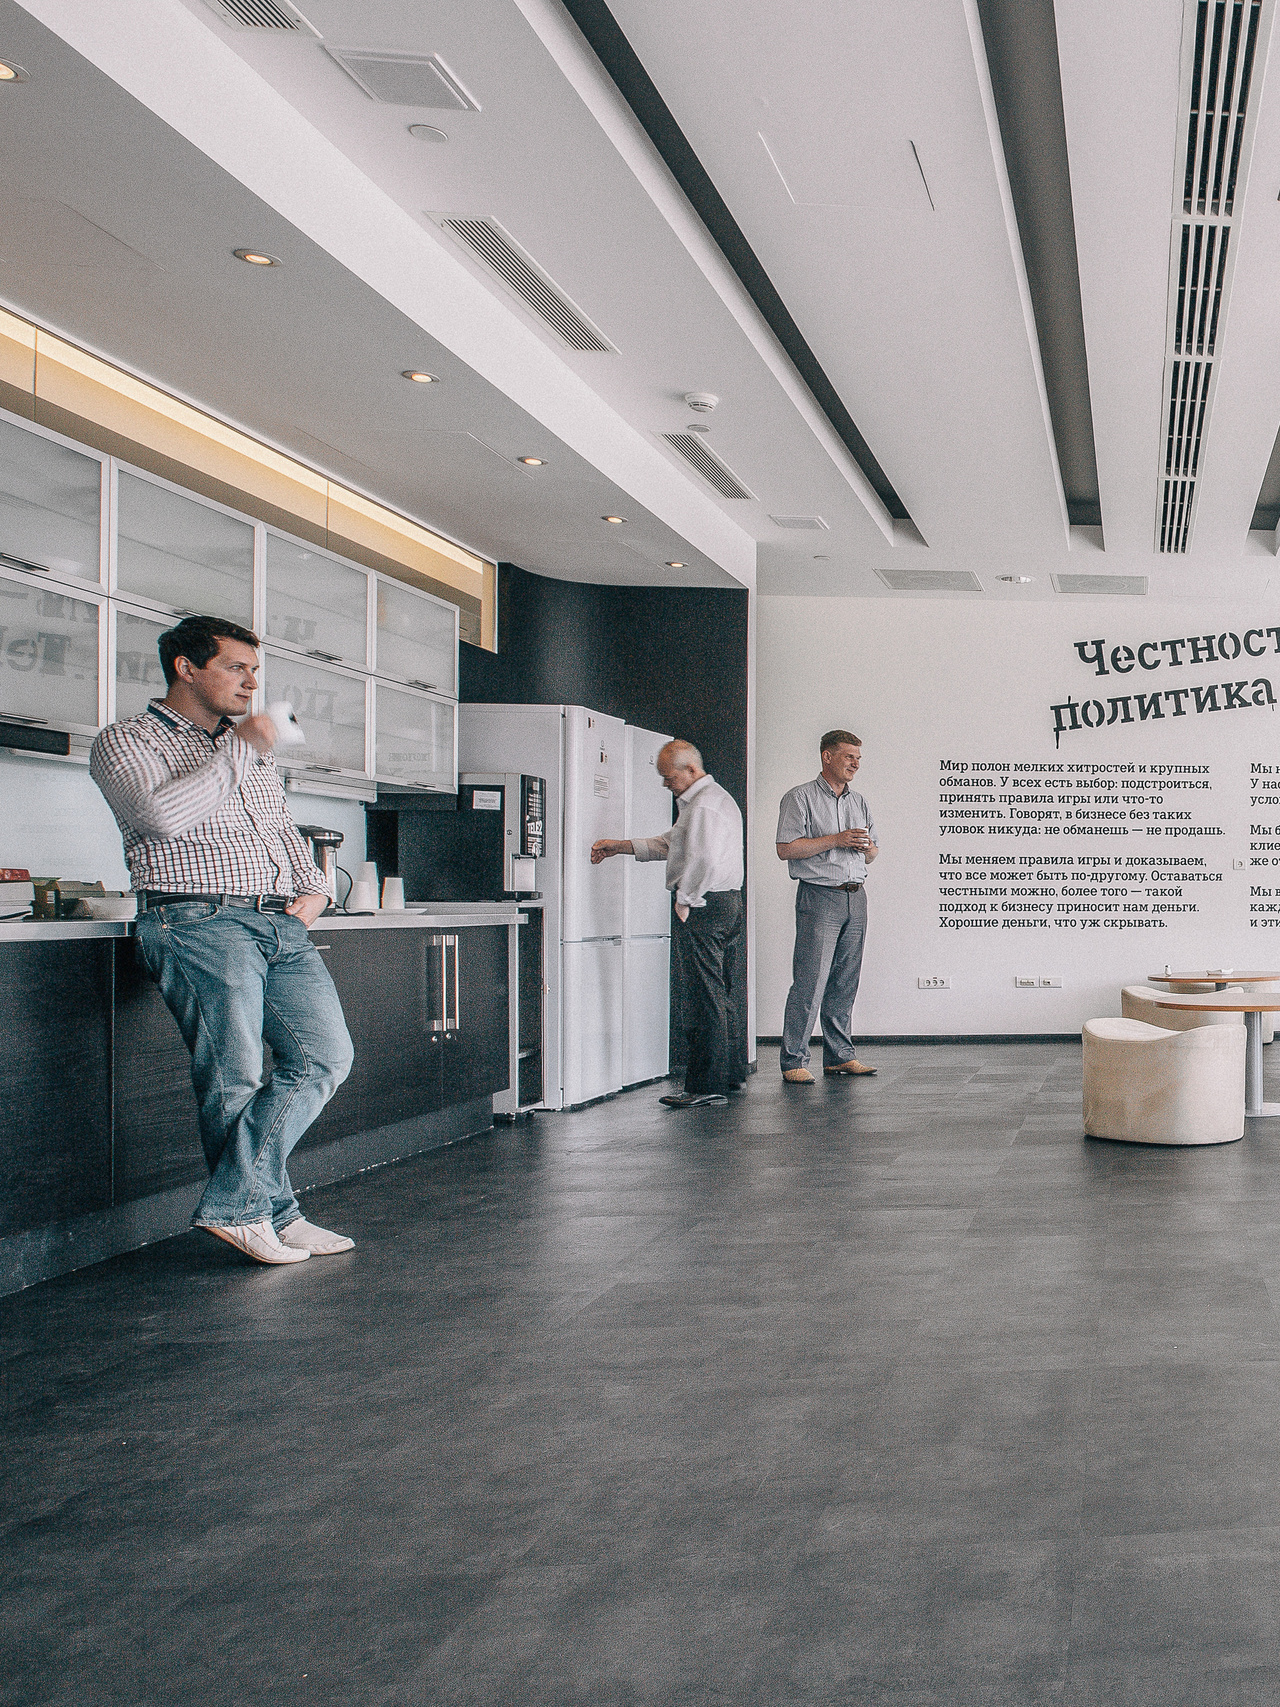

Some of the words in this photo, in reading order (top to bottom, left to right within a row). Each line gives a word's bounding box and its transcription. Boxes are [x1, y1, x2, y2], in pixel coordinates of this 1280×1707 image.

[1050, 677, 1278, 735] политика
[939, 758, 969, 776] Мир
[971, 762, 1011, 773] полон
[1013, 762, 1065, 773] мелких
[1066, 761, 1136, 776] хитростей
[1138, 764, 1147, 774] и
[1149, 764, 1210, 777] крупных
[1250, 761, 1273, 775] Мы
[938, 775, 997, 788] обманов.
[999, 775, 1010, 788] У
[1012, 778, 1042, 788] всех
[1044, 779, 1074, 789] есть
[1075, 777, 1118, 791] выбор:
[1121, 779, 1213, 792] подстроиться,
[1250, 777, 1260, 789] У
[939, 793, 997, 806] принять
[998, 794, 1055, 806] правила
[1057, 794, 1091, 807] игры
[1093, 795, 1119, 805] или
[1121, 795, 1164, 805] что-то
[939, 809, 1006, 819] изменить.
[1009, 807, 1063, 822] Говорят,
[1065, 810, 1073, 820] в
[1074, 808, 1127, 820] бизнесе
[1128, 808, 1150, 820] без
[1151, 811, 1192, 821] таких
[938, 824, 985, 837] уловок
[987, 825, 1042, 838] никуда:
[1044, 825, 1061, 836] не
[1062, 823, 1130, 836] обманешь
[1146, 826, 1163, 836] не
[1164, 826, 1226, 838] продашь.
[1249, 824, 1272, 836] Мы
[938, 853, 963, 865] Мы
[965, 855, 1016, 865] меняем
[1018, 856, 1075, 868] правила
[1077, 856, 1111, 868] игры
[1113, 856, 1123, 866] и
[1124, 856, 1207, 868] доказываем,
[1249, 857, 1269, 867] же
[938, 871, 963, 881] что
[965, 871, 988, 881] все
[989, 871, 1034, 881] может
[1035, 869, 1069, 881] быть
[1070, 871, 1148, 884] по-другому.
[1150, 869, 1223, 882] Оставаться
[938, 887, 1008, 897] честными
[1010, 887, 1059, 899] можно,
[1060, 885, 1098, 897] более
[1099, 887, 1129, 897] того
[1144, 885, 1183, 897] такой
[1250, 885, 1272, 897] Мы
[938, 903, 987, 914] подход
[989, 903, 999, 912] к
[1000, 901, 1054, 914] бизнесу
[1056, 903, 1120, 914] приносит
[1122, 903, 1149, 912] нам
[1151, 903, 1200, 914] деньги.
[938, 917, 999, 930] Хорошие
[1001, 919, 1051, 930] деньги,
[1053, 919, 1078, 928] что
[1079, 919, 1101, 930] уж
[1103, 919, 1168, 930] скрывать.
[1249, 918, 1258, 928] и
